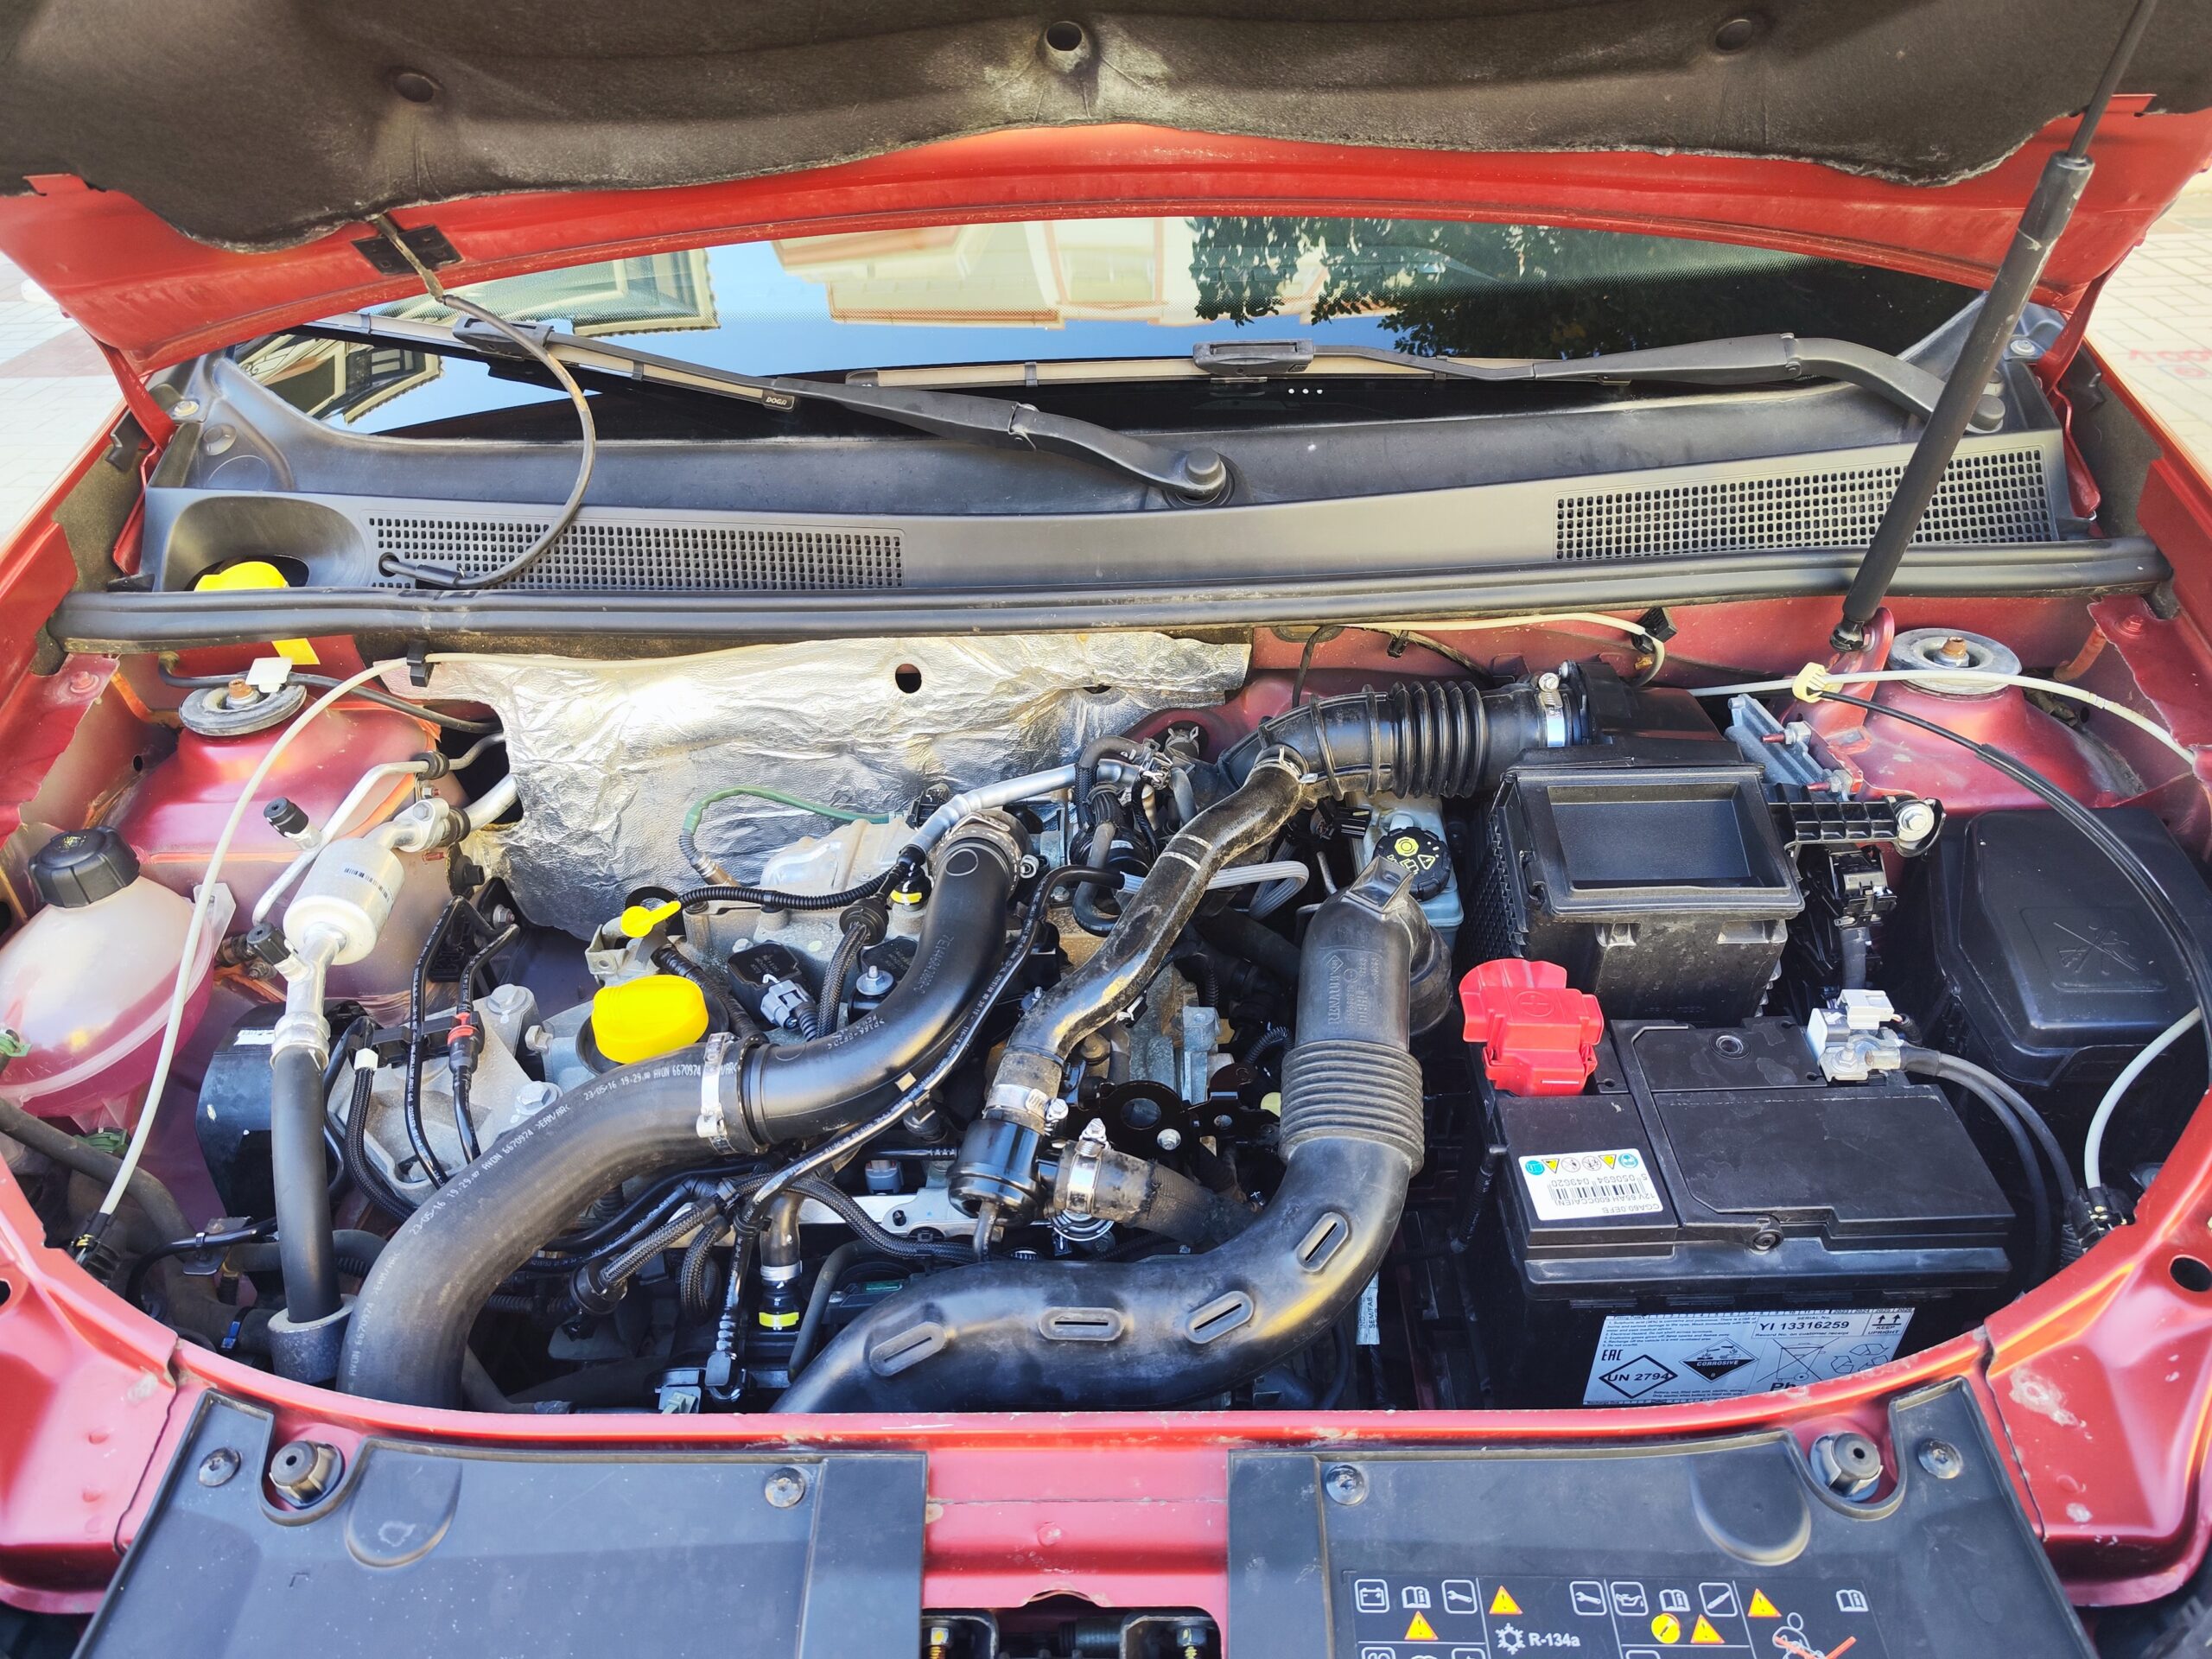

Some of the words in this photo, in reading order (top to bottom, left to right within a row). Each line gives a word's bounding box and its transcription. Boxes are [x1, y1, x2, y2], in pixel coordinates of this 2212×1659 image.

[766, 397, 787, 406] DOGA
[583, 1080, 618, 1101] 23/05/16
[653, 1065, 670, 1079] AVON
[410, 1200, 447, 1235] 23/05/16
[481, 1152, 504, 1171] AVON
[501, 1128, 535, 1154] 6670974
[1759, 1322, 1775, 1331] YI
[1780, 1321, 1849, 1331] 13316259
[1601, 1349, 1624, 1361] EAC
[1528, 1632, 1581, 1647] R-134a
